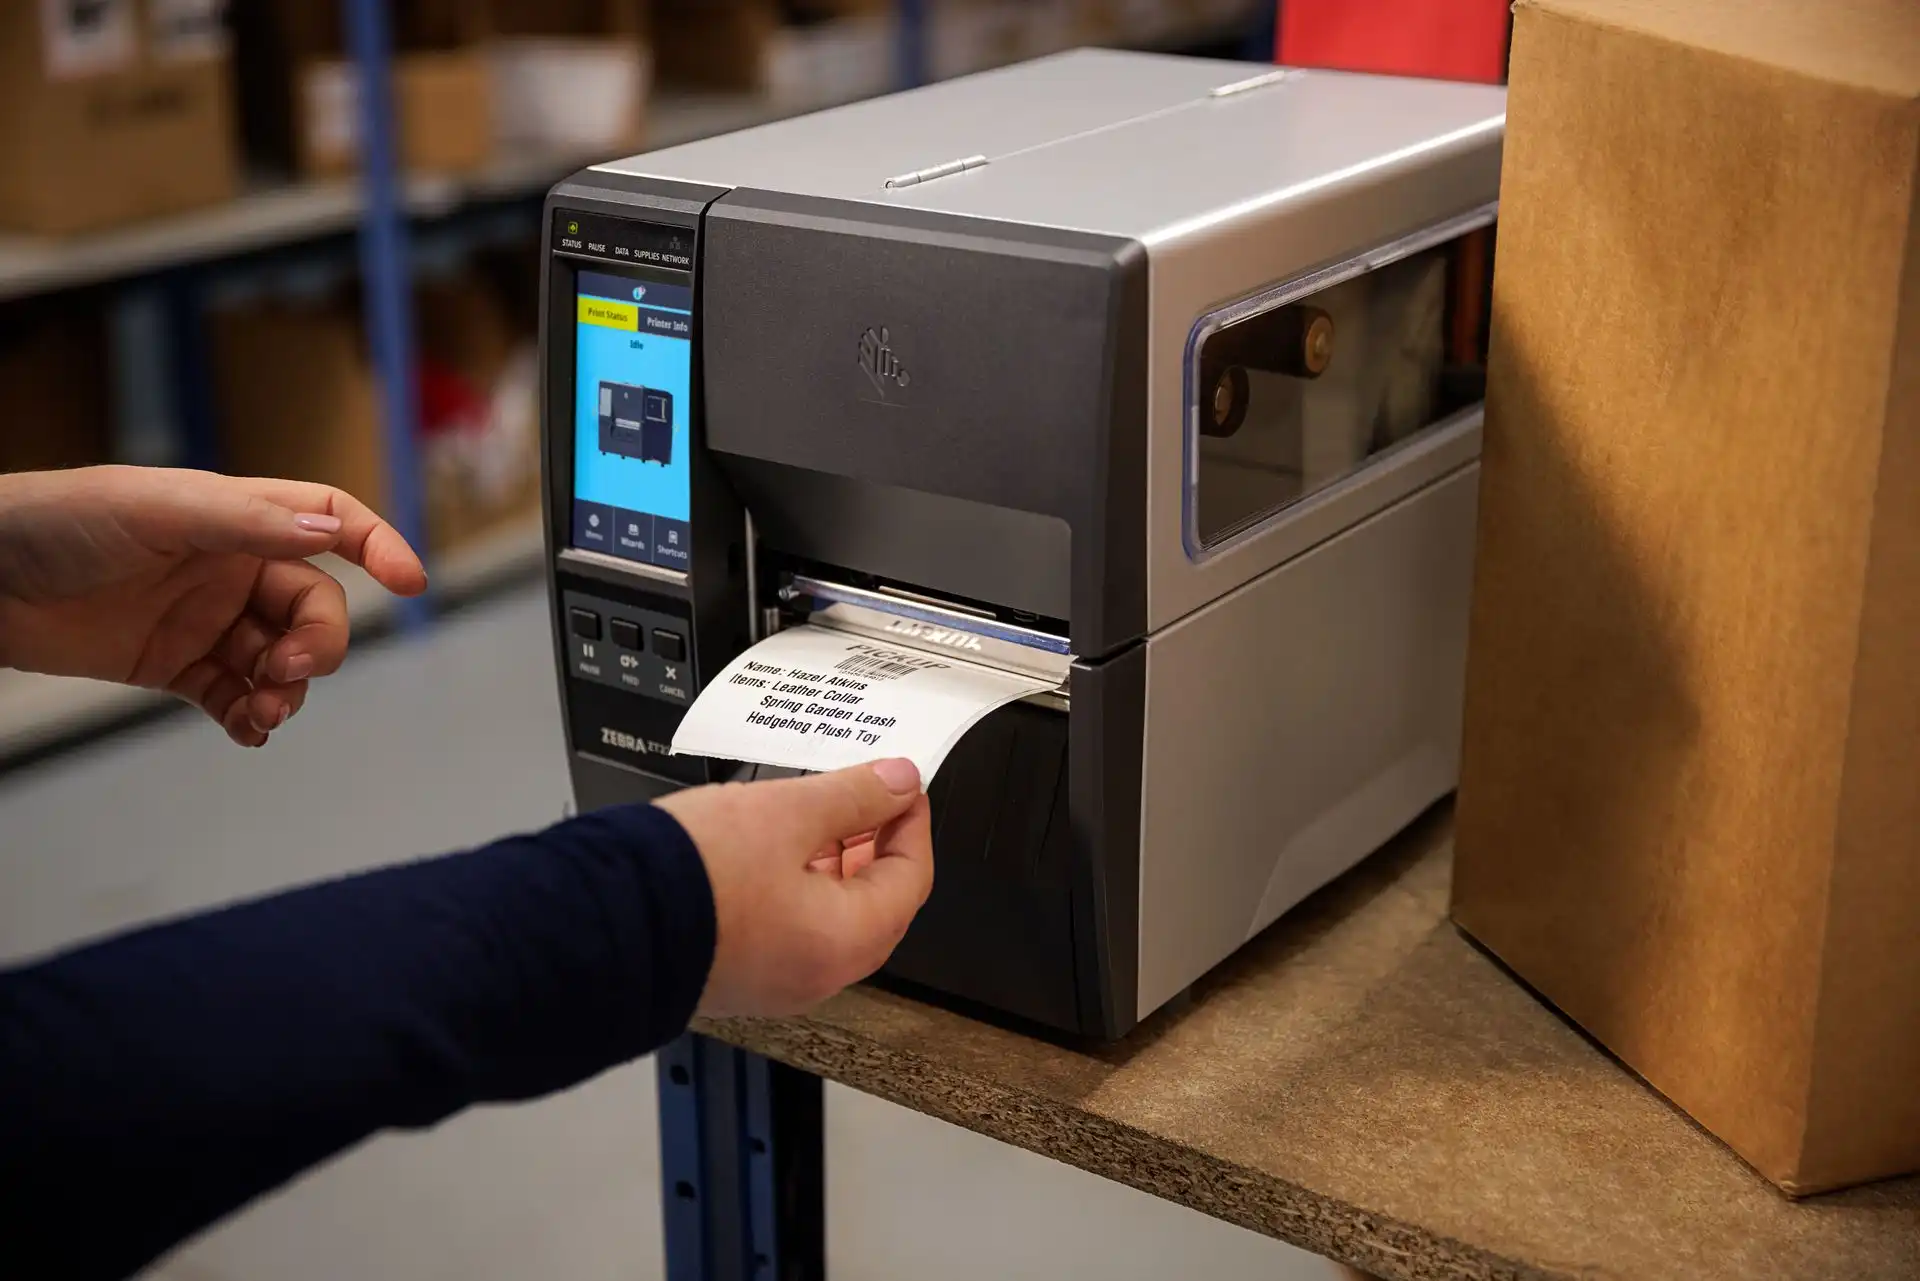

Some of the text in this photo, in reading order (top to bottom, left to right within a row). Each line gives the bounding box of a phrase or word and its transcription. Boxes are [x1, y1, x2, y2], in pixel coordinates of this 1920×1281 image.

[562, 239, 582, 249] STATUS
[588, 243, 606, 253] PAUSE
[615, 246, 629, 256] DATA
[634, 250, 660, 261] SUPPLIES
[661, 254, 690, 265] NETWORK
[588, 307, 628, 323] Print Status
[647, 316, 688, 332] Printer Info
[846, 644, 951, 669] PICKUP
[744, 660, 786, 676] Name:
[787, 668, 826, 683] Hazel
[825, 676, 868, 691] Atkins
[729, 673, 865, 705] Items: Leather Collar
[760, 695, 897, 728] Spring Garden Leash
[746, 711, 881, 746] Hedgehog Plush Toy
[601, 727, 647, 754] ZEBRA
